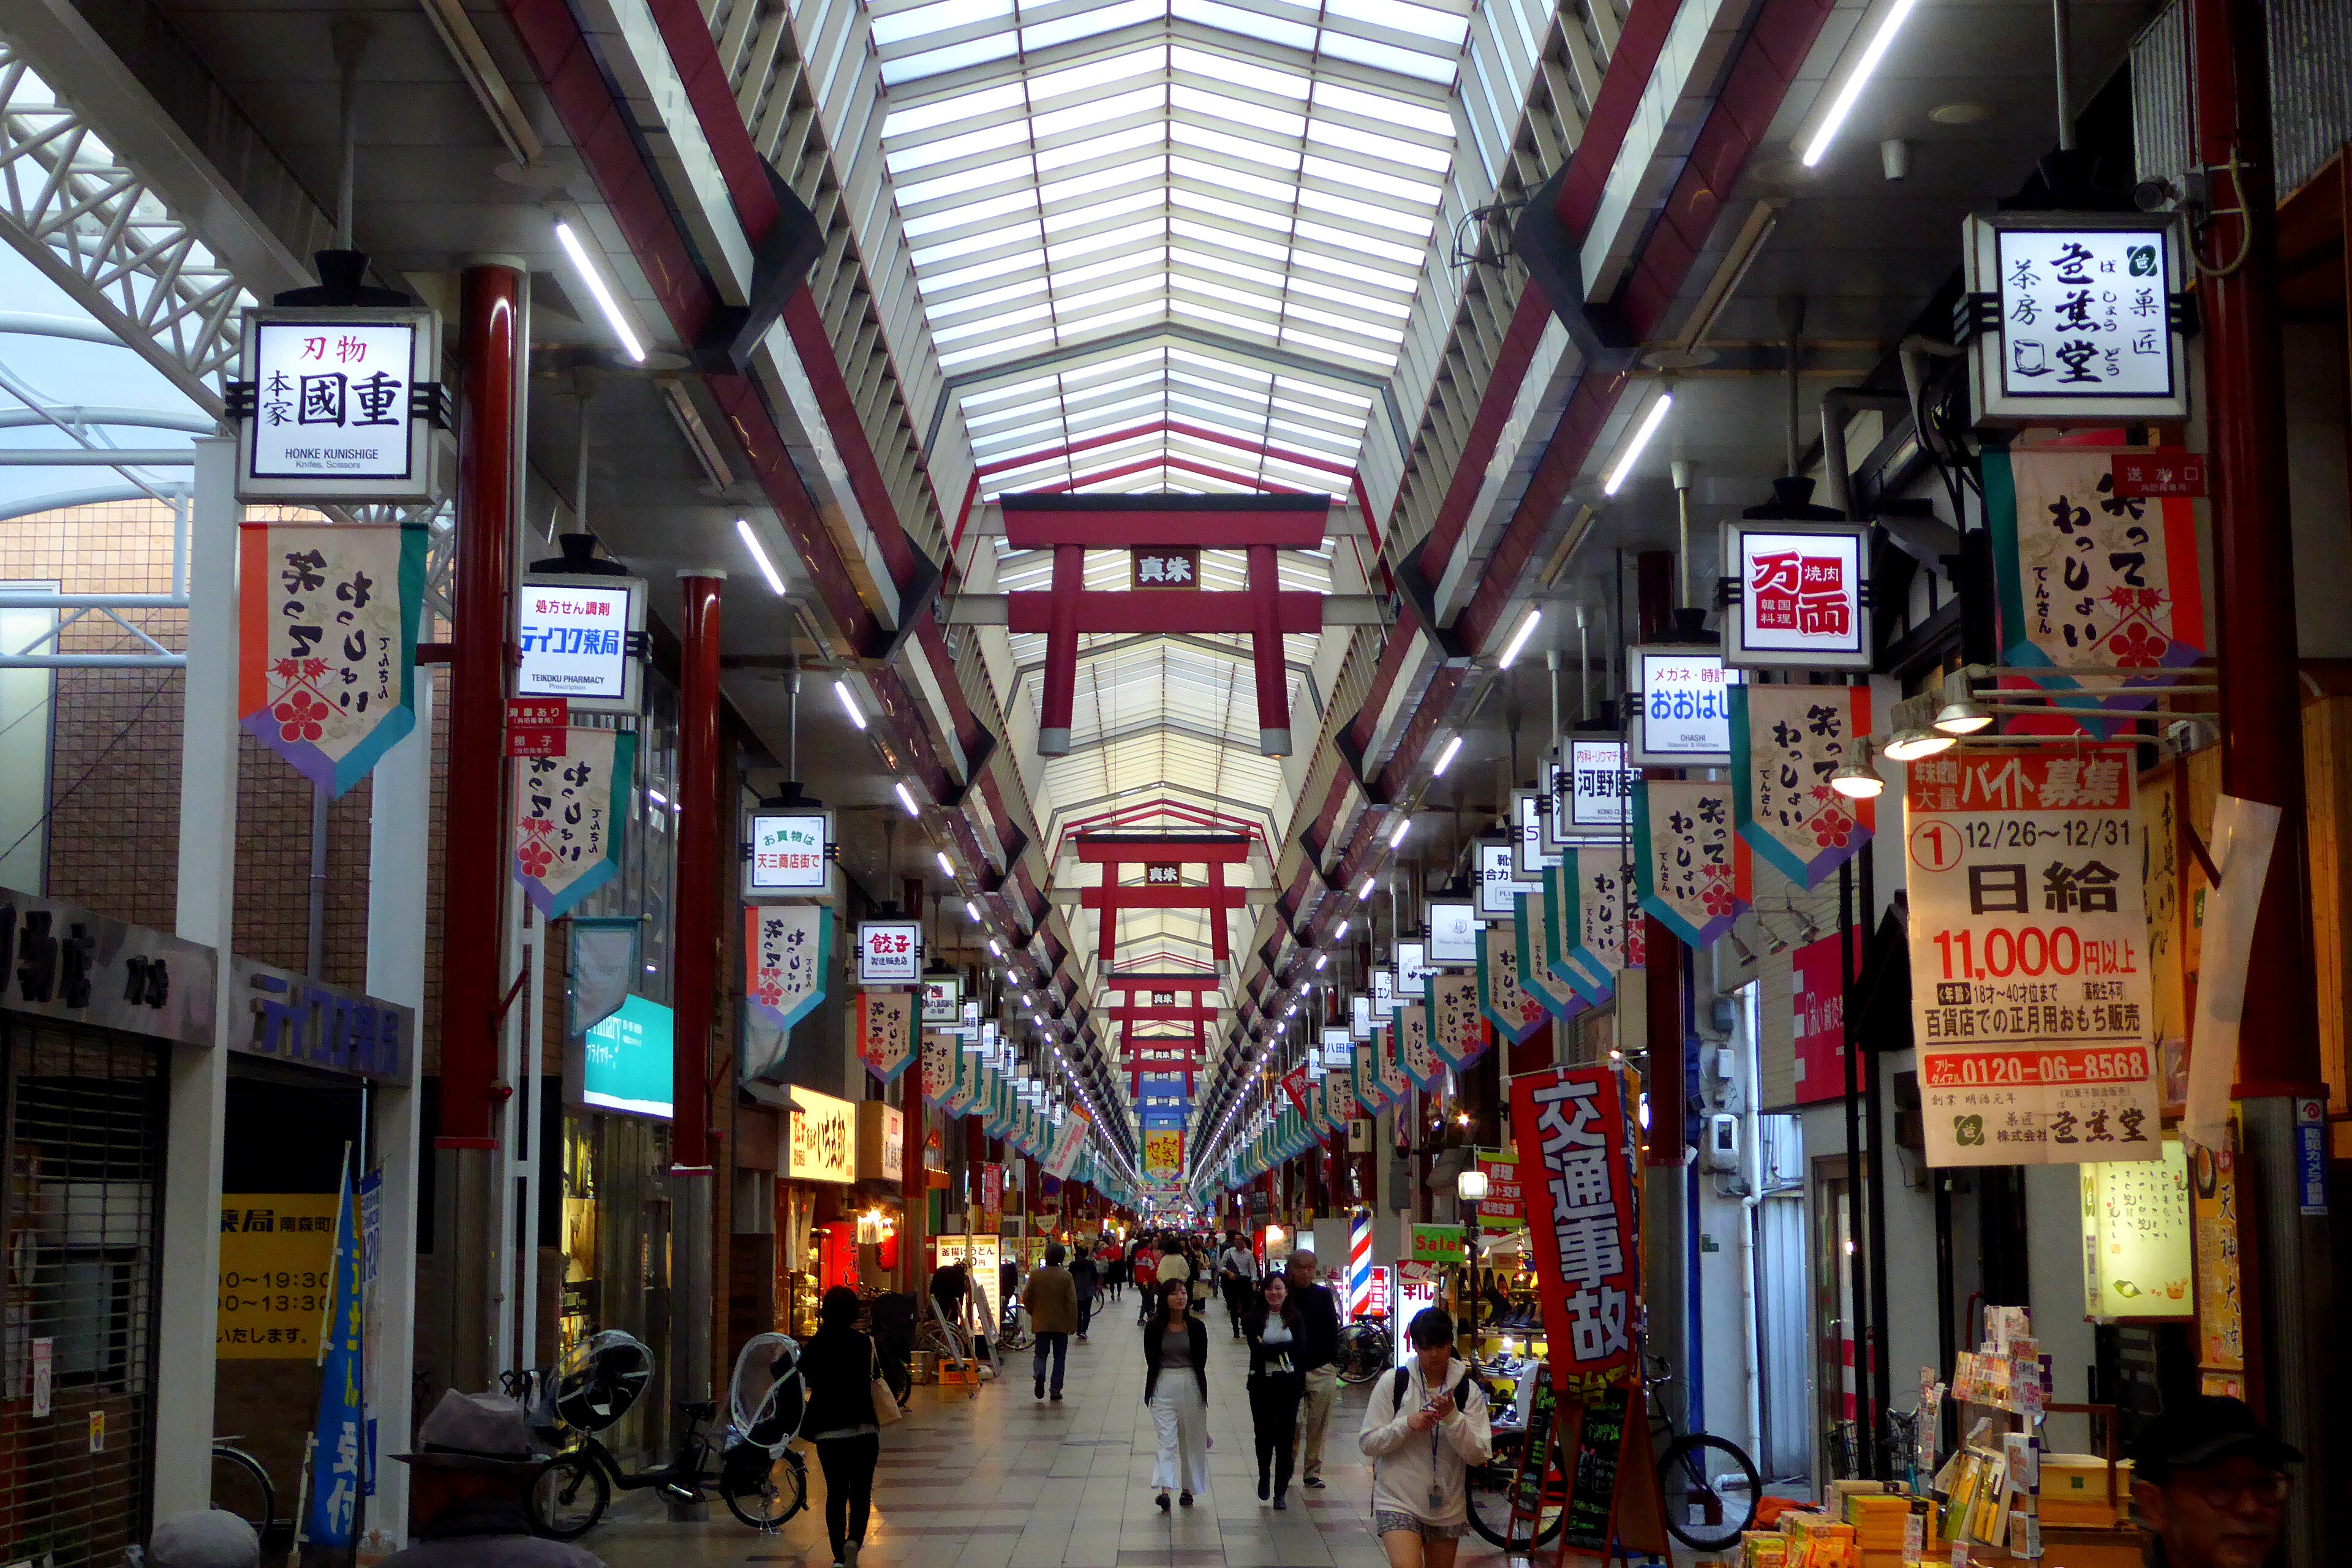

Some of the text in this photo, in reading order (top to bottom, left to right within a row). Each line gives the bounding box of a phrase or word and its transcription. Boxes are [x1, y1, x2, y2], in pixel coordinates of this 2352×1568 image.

[2008, 258, 2042, 325] 茶房
[2049, 242, 2103, 383] 芭蕉堂
[2099, 259, 2121, 377] ばしょうどう
[2129, 287, 2161, 355] 菓匠
[298, 334, 368, 363] 刃物
[263, 369, 295, 426] 本家
[297, 371, 402, 428] 國重
[285, 448, 379, 461] HONKE KUNISHIGE
[1139, 556, 1192, 582] 真朱
[1804, 565, 1839, 582] 焼肉
[2048, 495, 2097, 647] わっしょい
[535, 599, 611, 616] 処方せん調剤
[1760, 598, 1792, 611] 韓国
[2033, 565, 2051, 635] てんさん
[1760, 612, 1792, 625] 料理
[521, 627, 620, 657] テイコク薬局
[532, 674, 605, 684] TEIKOKU PHARMACY
[1654, 667, 1727, 683] メガネ・時計
[1772, 720, 1803, 826] わっしょい
[1961, 757, 2124, 809] バイト募集
[1758, 768, 1773, 817] てんさん
[1915, 787, 1959, 810] 大量
[763, 829, 816, 846] お買物は
[1697, 796, 1727, 864] 笑って
[1496, 854, 1512, 867] 靴
[1659, 851, 1671, 892] てんさん
[1669, 810, 1696, 900] わっしょい
[1968, 861, 2120, 914] 日給
[1594, 873, 1616, 950] わっしょい
[867, 933, 911, 955] 餃子
[1925, 1003, 2141, 1038] 百貨店での正月用おもち販売
[1962, 1052, 2144, 1083] 0120-06-8568
[1996, 1129, 2048, 1143] 株式会社
[280, 1216, 336, 1232] 南森町
[1532, 1080, 1629, 1362] 交通事故
